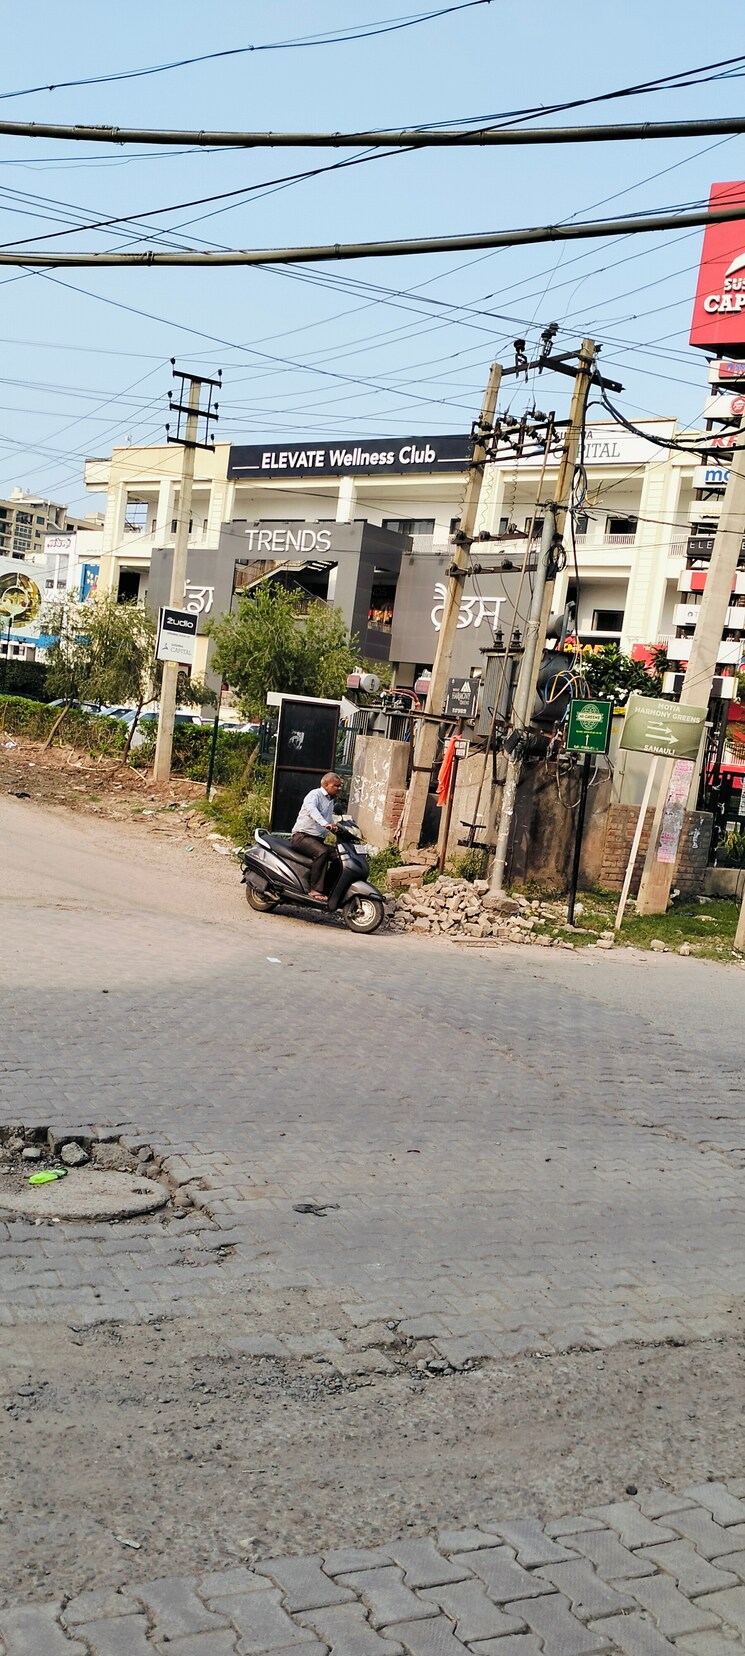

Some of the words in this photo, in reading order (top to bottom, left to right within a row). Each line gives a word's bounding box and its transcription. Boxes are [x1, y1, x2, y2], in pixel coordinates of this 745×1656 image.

[261, 450, 325, 469] ELEVATE
[329, 447, 395, 467] Wellness
[399, 444, 436, 464] Club
[552, 442, 621, 460] CPITAL
[244, 529, 332, 552] TRENDS
[634, 706, 673, 719] HARMONY
[672, 713, 701, 724] GREENS
[657, 702, 681, 712] MOTIA
[643, 744, 676, 756] SANAULI
